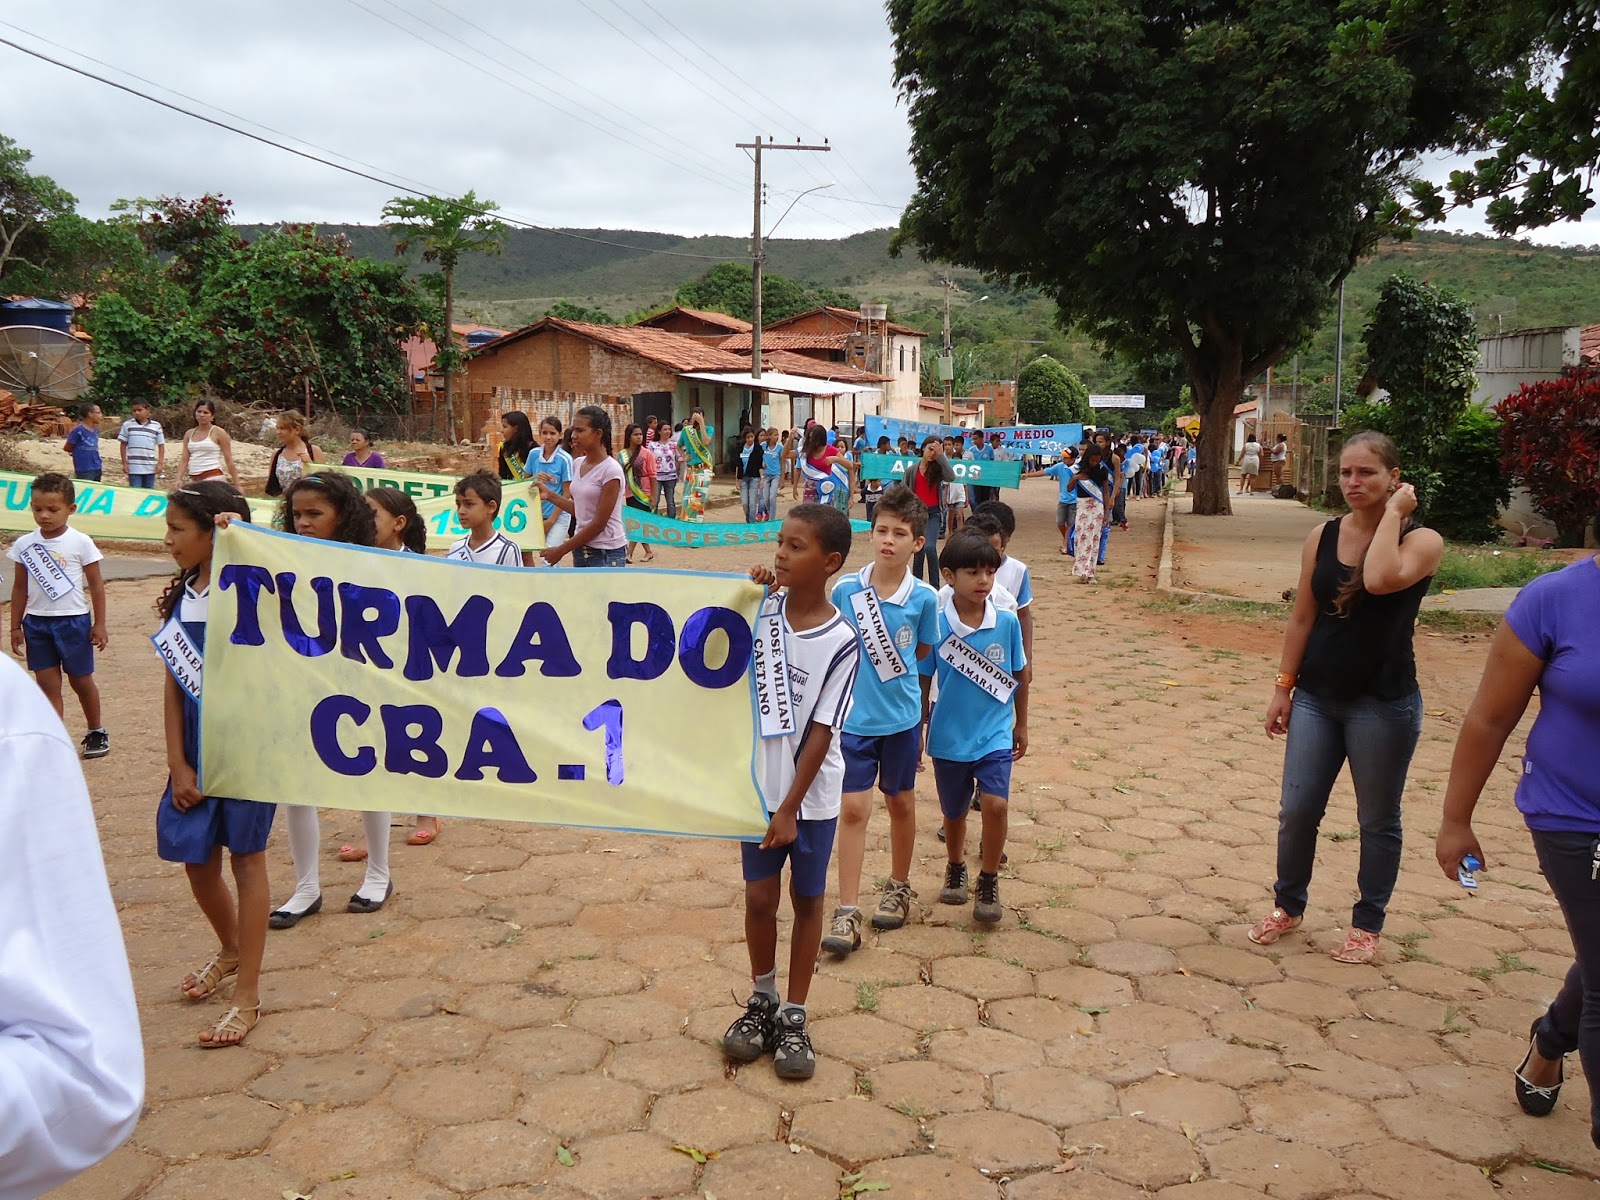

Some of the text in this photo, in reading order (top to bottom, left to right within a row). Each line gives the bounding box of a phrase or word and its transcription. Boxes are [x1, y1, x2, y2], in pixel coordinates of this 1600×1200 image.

[961, 431, 1007, 440] ENINO
[1014, 428, 1054, 440] MÉDIO
[891, 460, 981, 480] AOS
[431, 498, 528, 535] 196
[625, 518, 779, 545] PROFESSO
[33, 543, 62, 580] IZAQUEU
[219, 564, 753, 688] TURMA DO
[864, 591, 902, 674] MAXIMILIANO
[160, 640, 178, 667] DOS
[860, 627, 882, 667] ALVES
[948, 638, 994, 674] ANTÔNIO
[993, 668, 1015, 689] DOS
[754, 638, 771, 716] CAETANO
[769, 618, 791, 730] JOSÉ WILLIAN
[957, 664, 999, 697] AMARAL
[310, 694, 537, 784] CBA
